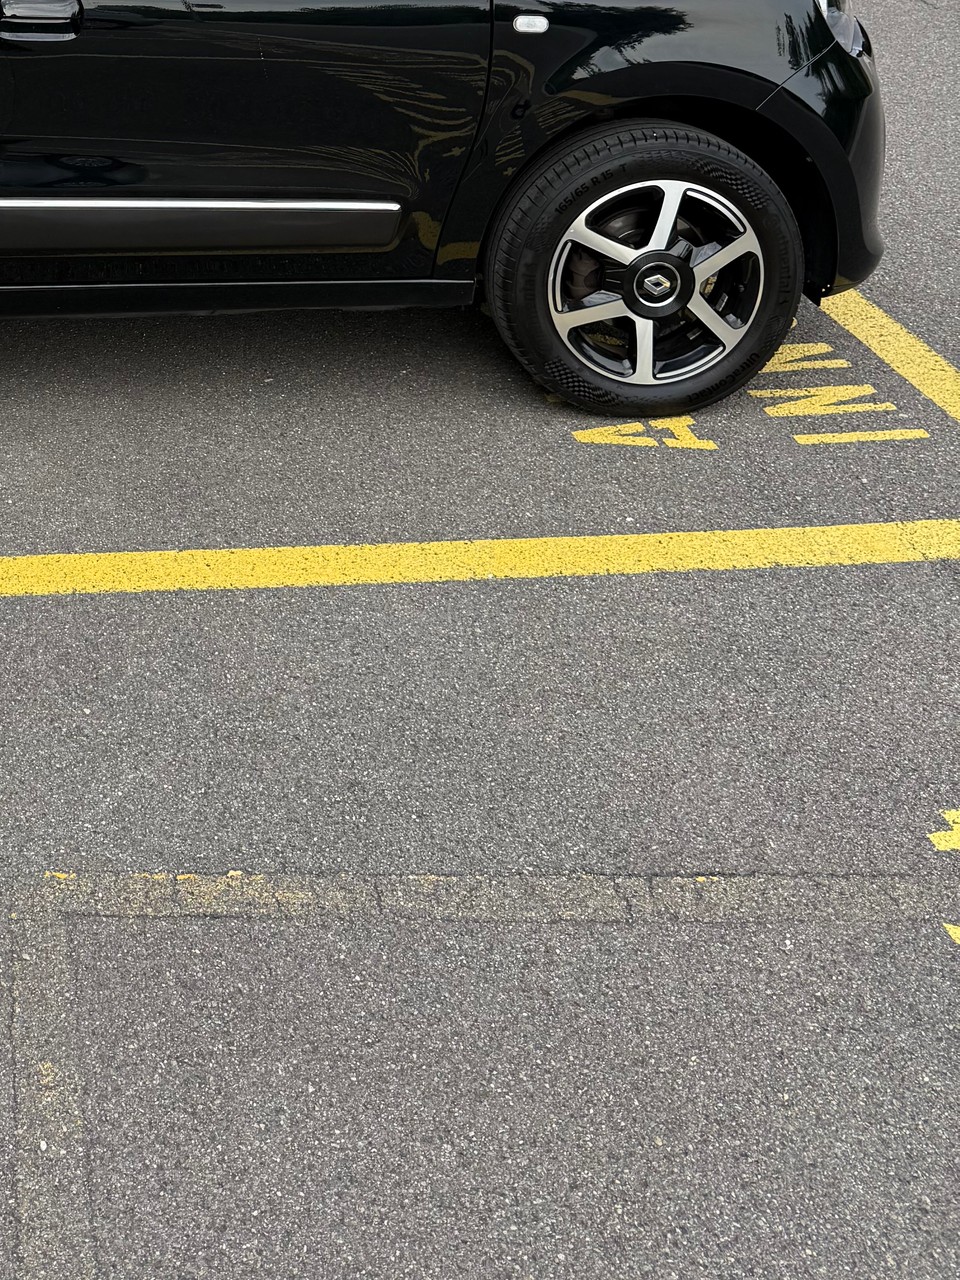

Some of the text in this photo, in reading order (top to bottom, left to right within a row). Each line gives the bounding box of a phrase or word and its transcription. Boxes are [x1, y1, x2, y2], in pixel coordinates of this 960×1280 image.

[554, 183, 590, 215] 165/65
[590, 176, 601, 186] R
[600, 169, 614, 180] 15
[686, 352, 760, 402] UltraContact
